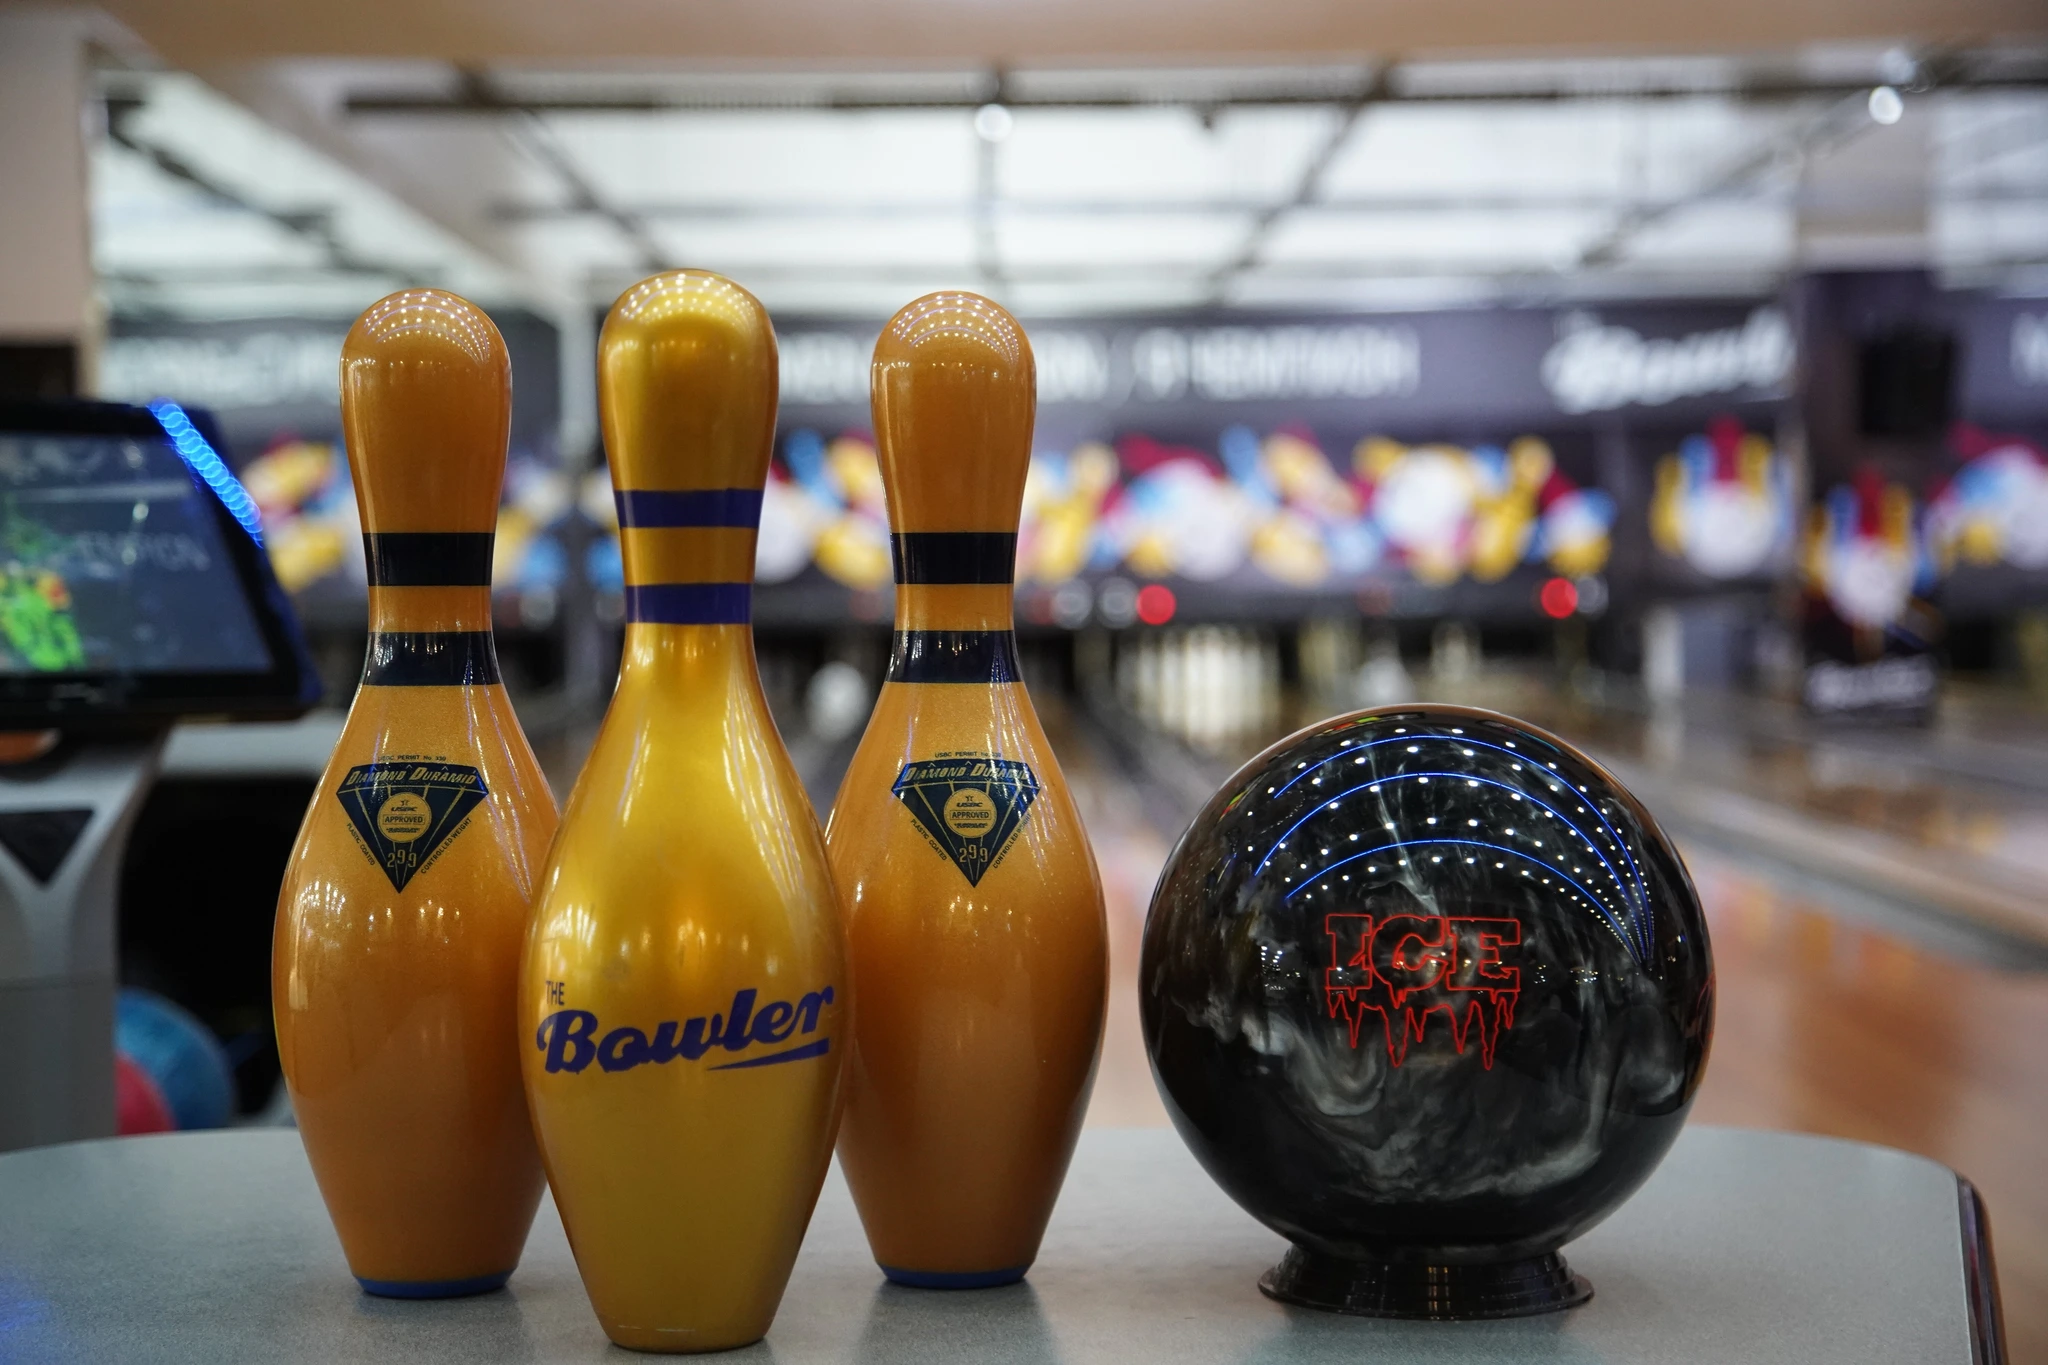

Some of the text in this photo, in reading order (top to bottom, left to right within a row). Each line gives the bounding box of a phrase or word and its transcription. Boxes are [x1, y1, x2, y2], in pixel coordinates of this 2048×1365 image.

[346, 767, 477, 786] DIAMOND DURAMID
[903, 766, 966, 782] DIAMOND
[952, 811, 990, 819] APPROVED
[346, 823, 376, 866] PLASTIC COATED
[421, 817, 472, 874] CONTROLLED WEIGHT
[910, 819, 948, 861] PLASTIC COATED
[959, 844, 988, 863] 299
[993, 833, 1019, 869] CONTROLLED
[387, 849, 417, 868] 299
[1326, 914, 1521, 1009] ICE
[545, 980, 565, 1006] THE
[536, 986, 834, 1075] Bowler
